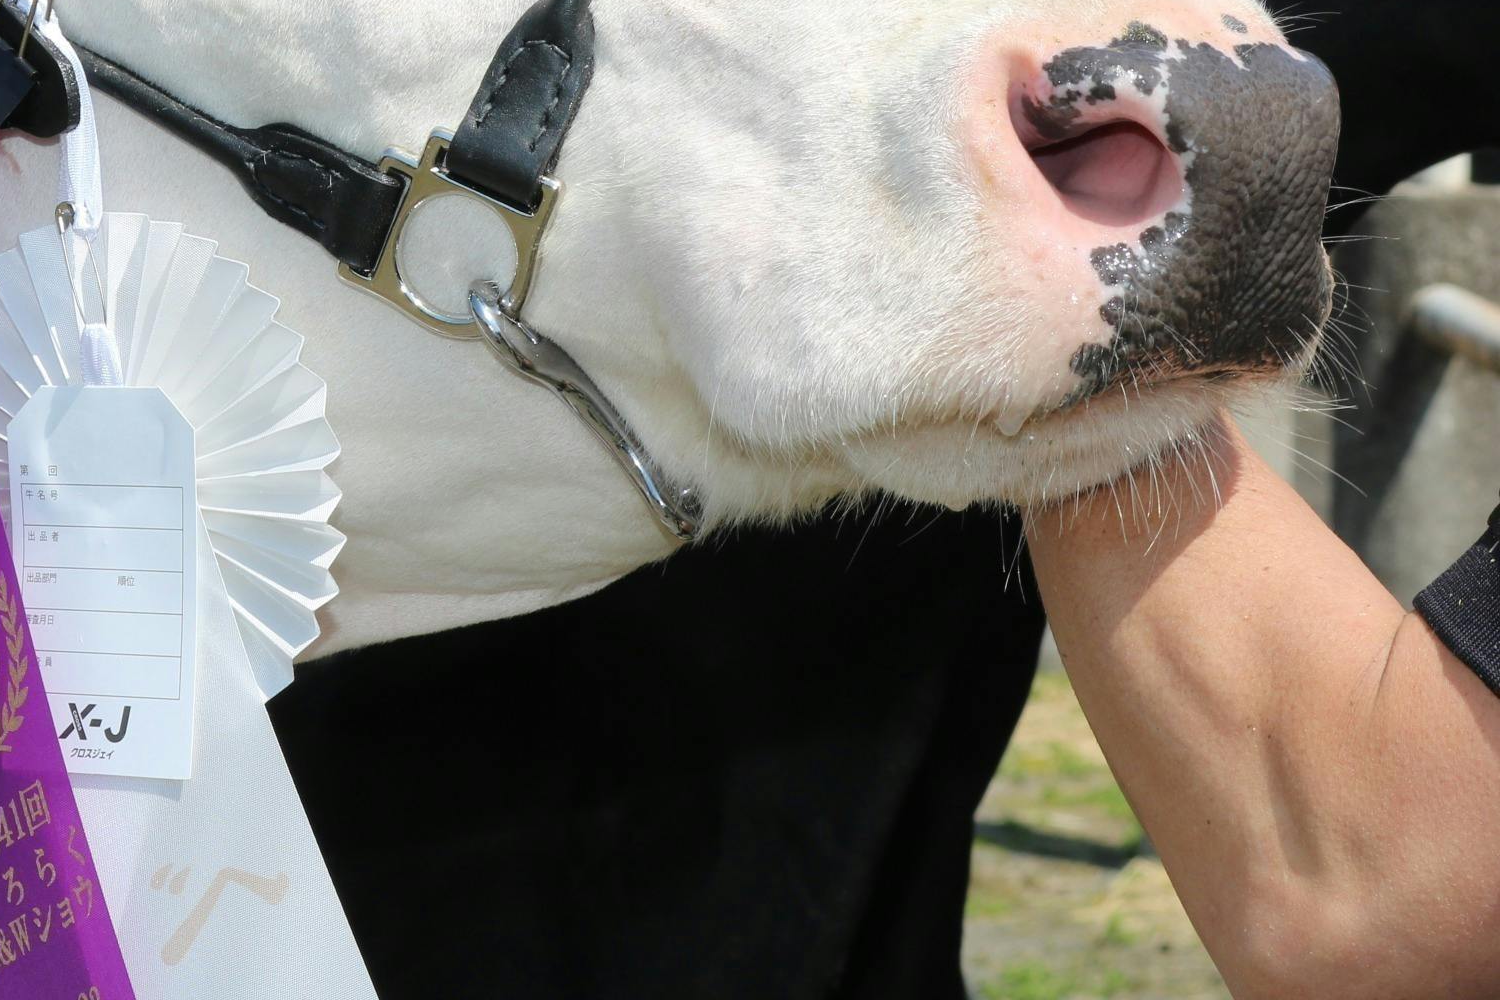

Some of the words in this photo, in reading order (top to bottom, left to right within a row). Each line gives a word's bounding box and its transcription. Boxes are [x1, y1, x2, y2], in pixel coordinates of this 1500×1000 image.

[27, 530, 59, 542] 出品者
[26, 571, 57, 584] 出品部門
[117, 575, 136, 587] 順位
[58, 702, 132, 743] X-J
[70, 747, 115, 760] クロスジェイ
